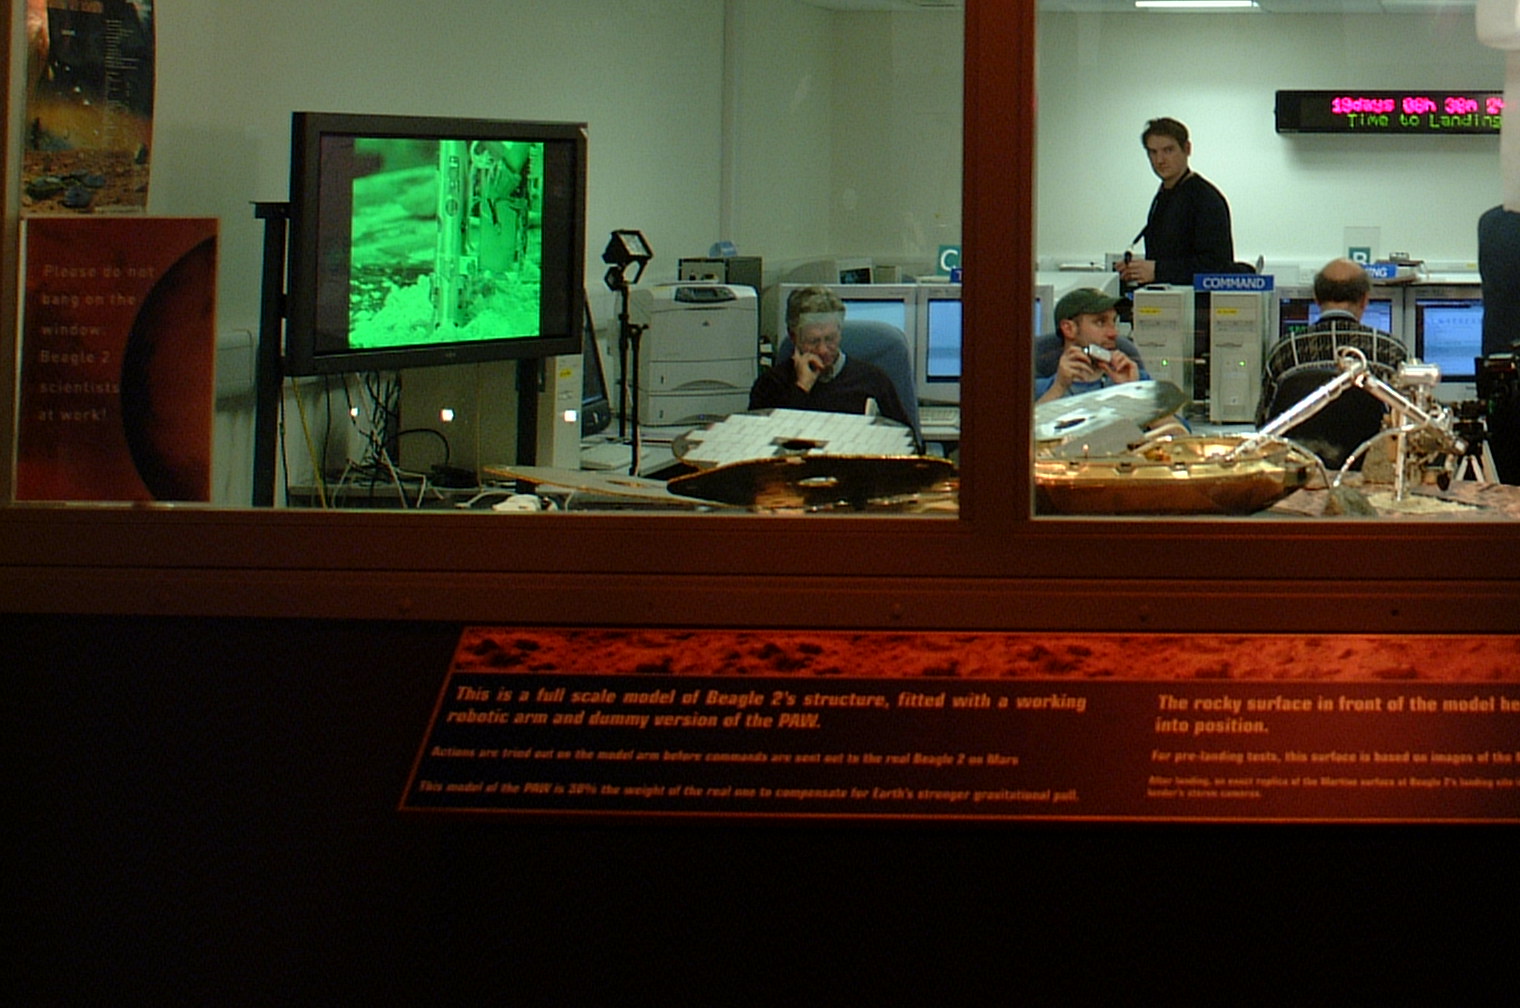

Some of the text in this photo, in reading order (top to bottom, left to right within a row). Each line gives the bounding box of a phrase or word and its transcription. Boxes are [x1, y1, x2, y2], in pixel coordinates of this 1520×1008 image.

[1348, 114, 1503, 129] Time to Landing
[43, 264, 155, 278] Please do not
[1202, 277, 1266, 289] COMMAND
[41, 293, 136, 308] bang on the
[40, 350, 111, 365] Beagle 2
[40, 382, 120, 393] scientists
[39, 408, 107, 421] at work!
[456, 685, 1088, 711] This is a full scale model of Beagle 2's structure, fitted with a working
[1159, 694, 1188, 711] The
[1193, 694, 1241, 714] rocky
[1247, 694, 1312, 711] surface
[1317, 694, 1333, 711] in
[1338, 694, 1381, 711] front
[1387, 694, 1404, 711] of
[1409, 694, 1437, 711] the
[1442, 694, 1494, 711] model
[446, 709, 821, 728] robotic arm and dummy version of the PAW.
[1155, 717, 1268, 736] into position.
